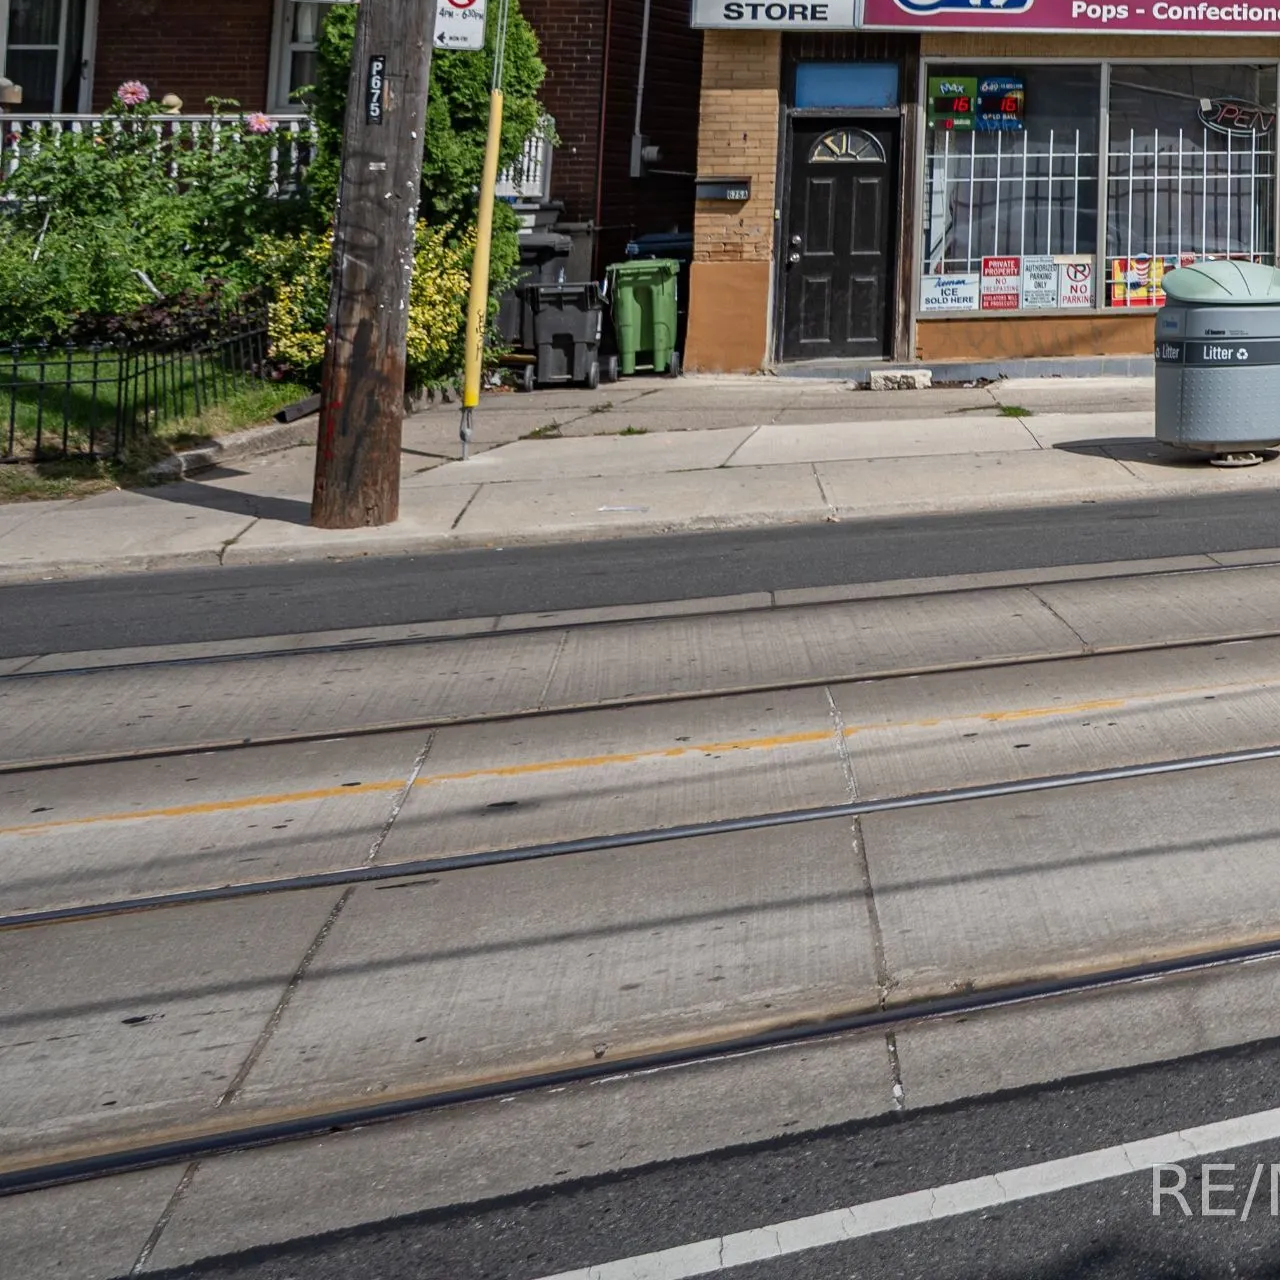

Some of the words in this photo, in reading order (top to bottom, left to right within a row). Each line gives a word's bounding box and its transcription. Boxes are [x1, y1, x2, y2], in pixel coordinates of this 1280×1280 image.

[723, 3, 829, 21] STORE
[1072, 1, 1129, 22] Pops
[370, 61, 383, 117] P675
[953, 95, 970, 112] 16
[1001, 96, 1017, 112] 16
[1201, 102, 1276, 131] OPEN
[988, 260, 1016, 268] PRIVATE
[1025, 264, 1057, 272] AUTHORIZED
[985, 268, 1018, 276] PROPERTY
[1034, 281, 1047, 289] ONLY
[1070, 284, 1088, 294] NO
[940, 288, 958, 297] ICE
[950, 296, 974, 304] HERE
[1062, 294, 1096, 304] PARKING
[1162, 344, 1180, 358] Litter
[1203, 345, 1234, 360] Litter
